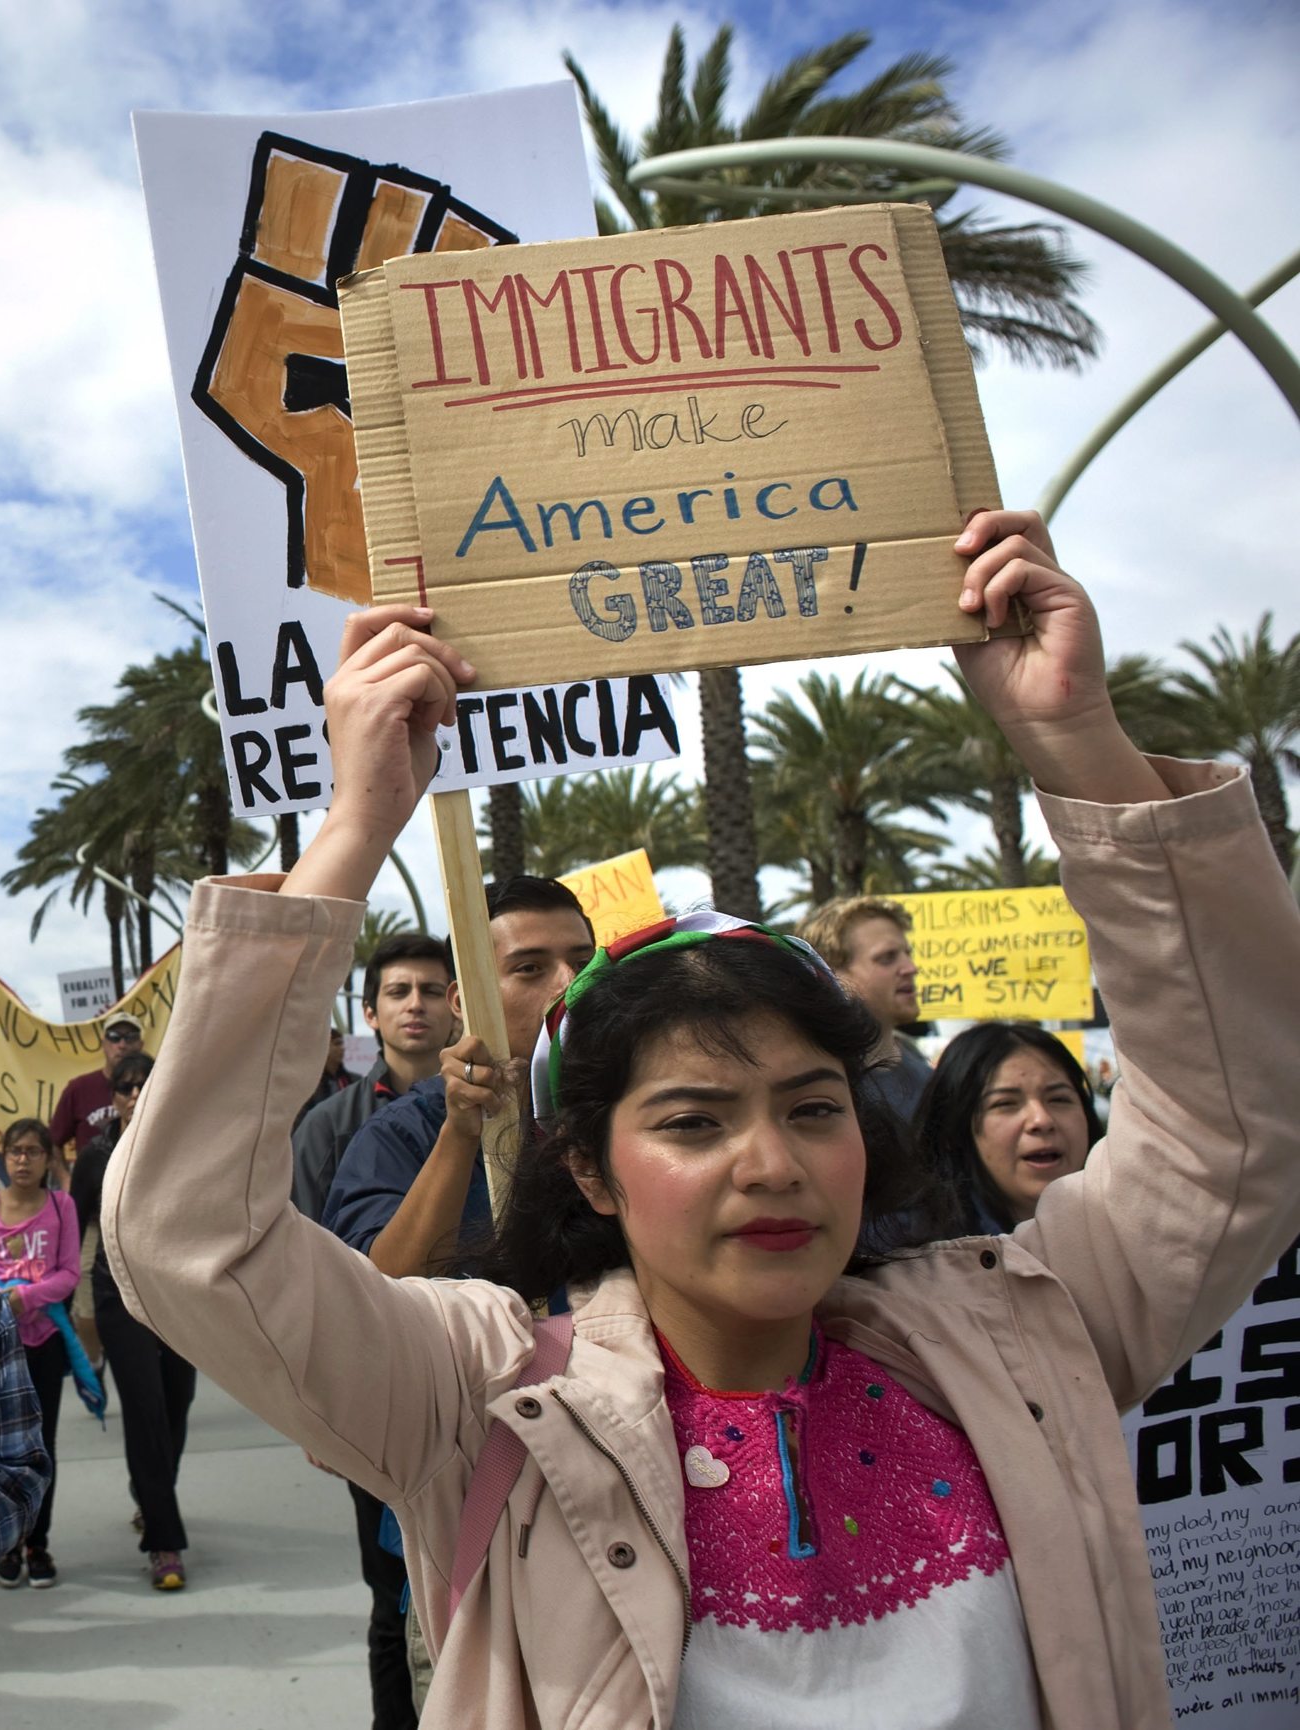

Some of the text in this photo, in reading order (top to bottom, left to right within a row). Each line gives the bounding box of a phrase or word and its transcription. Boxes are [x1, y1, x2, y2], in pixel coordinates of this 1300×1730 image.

[400, 243, 902, 388] IMMIGRANTS
[559, 396, 788, 458] make
[455, 472, 859, 558] America
[568, 542, 867, 643] GREAT!
[217, 621, 324, 716] LA
[231, 675, 680, 808] RETENCIA
[903, 896, 1074, 931] PILGRIMS WE
[913, 930, 1086, 959] NDOCUMENTED
[968, 957, 1009, 977] WE
[1025, 955, 1064, 973] LET
[63, 977, 110, 994] EQUALITY
[92, 993, 110, 1005] ALL
[917, 978, 1058, 1004] HEM STAY
[1137, 1406, 1264, 1505] OR
[1145, 1523, 1170, 1544] my
[1174, 1508, 1218, 1532] dad,
[1221, 1508, 1249, 1529] my
[1179, 1527, 1247, 1556] friends,
[1249, 1525, 1273, 1541] my
[1183, 1554, 1209, 1575] my
[1217, 1570, 1244, 1590] my
[1252, 1562, 1300, 1580] docto
[1163, 1600, 1185, 1615] lab
[1253, 1581, 1279, 1597] the
[1169, 1610, 1214, 1636] young
[1254, 1615, 1270, 1629] of
[1190, 1671, 1214, 1683] the
[1222, 1692, 1243, 1708] all
[1252, 1686, 1300, 1705] immig
